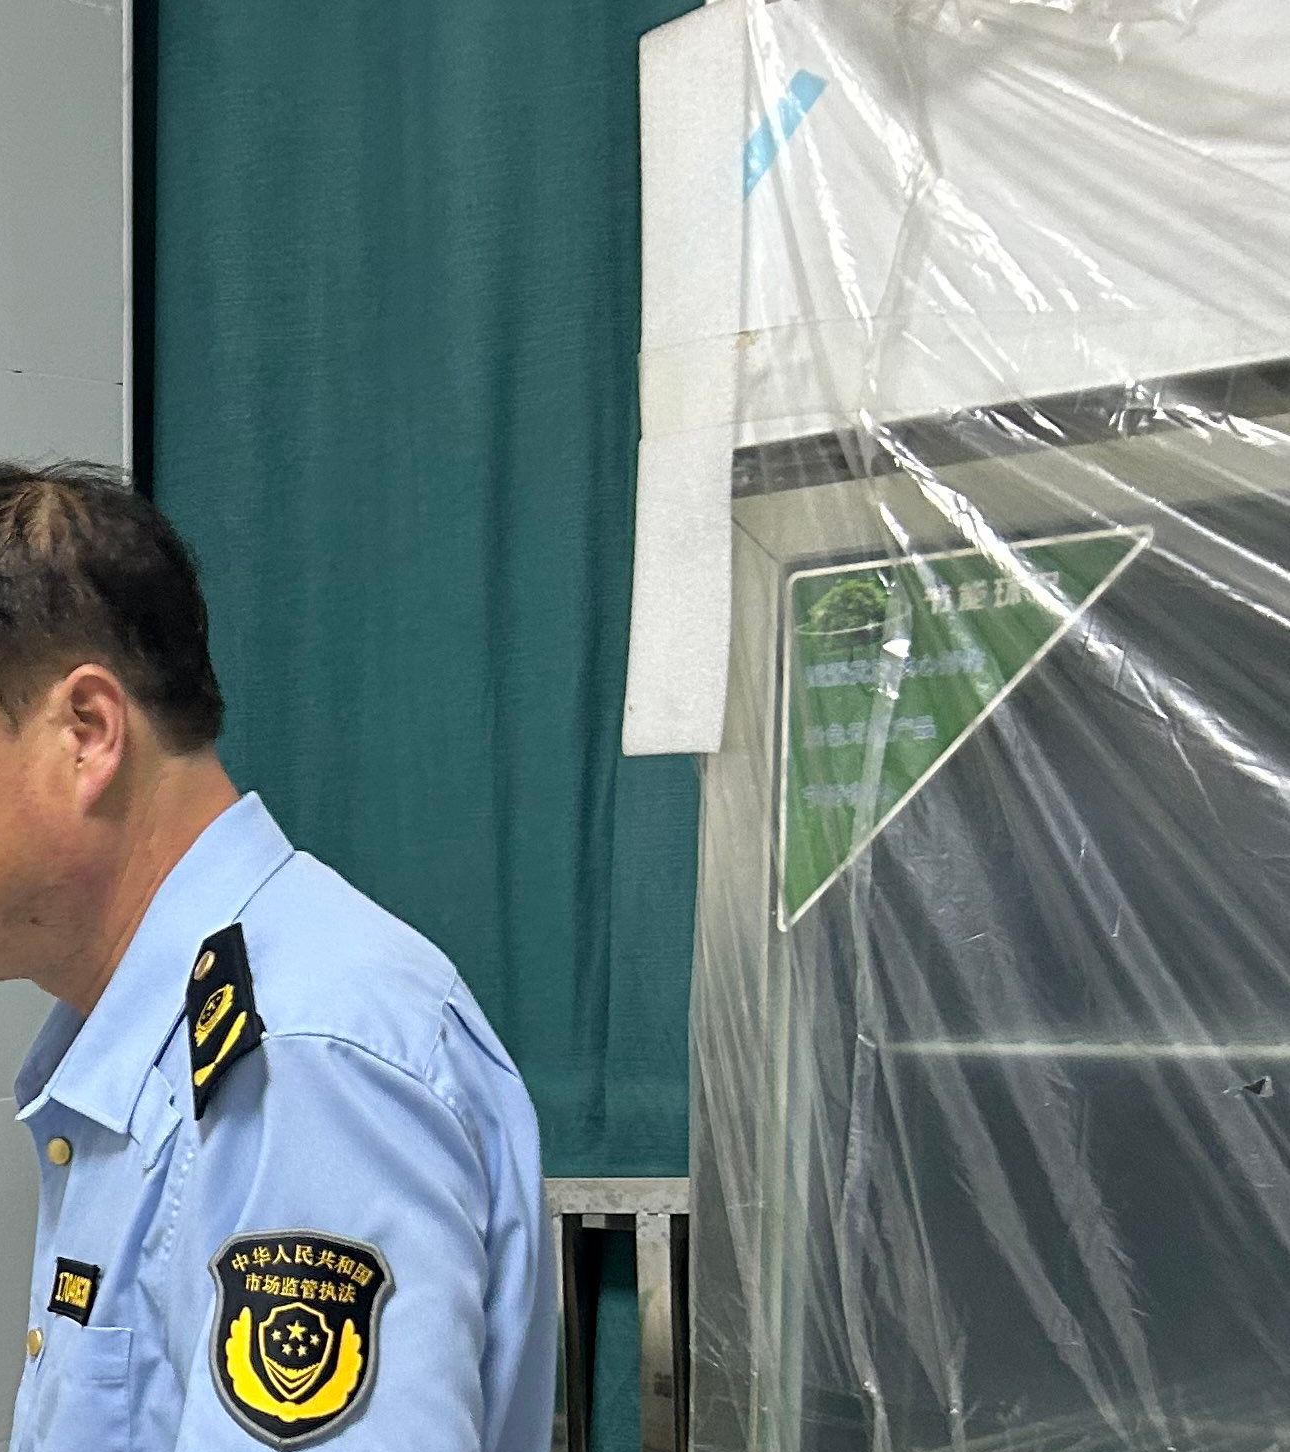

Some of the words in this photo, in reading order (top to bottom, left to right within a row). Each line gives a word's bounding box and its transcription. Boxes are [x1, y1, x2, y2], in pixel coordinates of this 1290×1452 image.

[231, 1243, 375, 1287] 中华人民共和国
[245, 1272, 358, 1304] 市场监管执法
